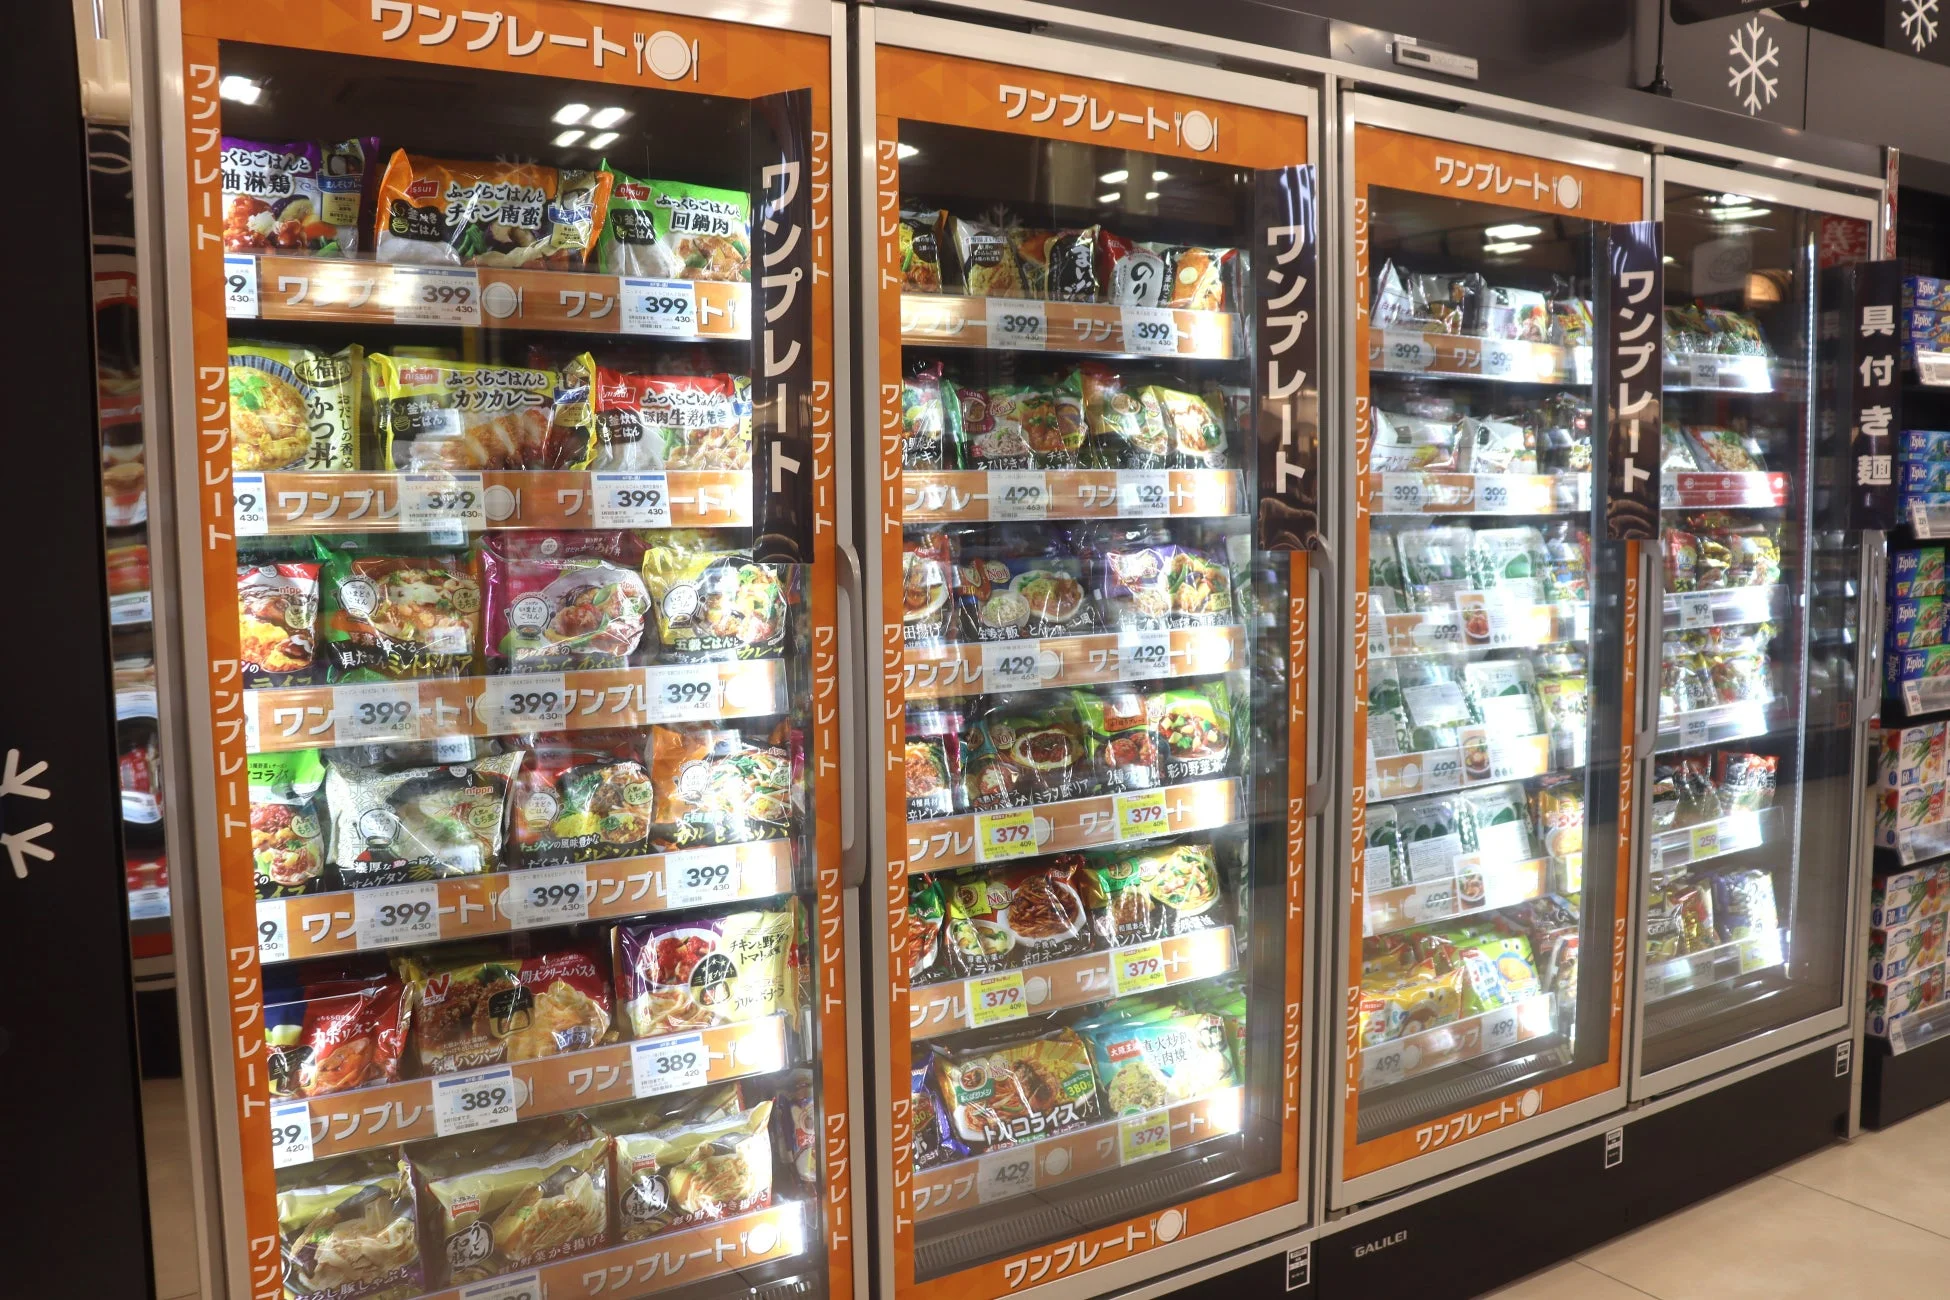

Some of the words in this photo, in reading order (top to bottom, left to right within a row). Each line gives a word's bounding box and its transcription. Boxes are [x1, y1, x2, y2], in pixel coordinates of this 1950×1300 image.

[371, 0, 627, 68] ワンプレート
[999, 83, 1171, 141] ワンプレート
[190, 64, 221, 250] ワンプレート
[221, 169, 292, 193] 油淋鶏
[1434, 155, 1550, 201] ワンプレート
[446, 204, 542, 227] チキン南蛮
[811, 131, 830, 285] ワンプレート
[878, 139, 898, 290] ワンプレート
[671, 212, 730, 235] 回鍋肉
[1355, 197, 1368, 320] ワンプレート
[422, 284, 471, 304] 399
[1918, 281, 1936, 297] Ziploc
[645, 296, 688, 315] 399
[762, 161, 803, 493] ワンプレート
[1003, 314, 1040, 333] 399
[1137, 321, 1170, 340] 399
[1913, 313, 1931, 328] Ziploc
[1266, 225, 1308, 494] ワンプレート
[446, 370, 546, 387] ふっくらごはんと
[1618, 270, 1656, 494] ワンプレート
[455, 389, 542, 409] カツカレー
[1857, 305, 1896, 487] 具付き麺
[307, 399, 338, 470] かつ丼
[1911, 434, 1926, 450] Ziploc
[200, 366, 232, 551] ワンプレート
[812, 379, 832, 534] ワンプレート
[881, 383, 900, 534] ワンプレート
[1355, 397, 1368, 518] ワンプレート
[1911, 466, 1928, 480] Ziploc
[427, 491, 476, 510] 399
[617, 490, 661, 507] 399
[1004, 486, 1040, 504] 429
[1898, 556, 1918, 573] Ziploc
[1898, 606, 1917, 622] Ziploc
[1133, 646, 1165, 664] 429
[1291, 598, 1305, 722] ワンプレート
[1354, 591, 1368, 713] ワンプレート
[1905, 654, 1925, 672] Ziploc
[1000, 656, 1035, 676] 429
[510, 693, 558, 715] 399
[667, 682, 712, 704] 399
[815, 626, 837, 777] ワンプレート
[883, 624, 903, 771] ワンプレート
[360, 702, 412, 724] 399
[213, 659, 247, 838] ワンプレート
[1432, 761, 1457, 777] 699
[1131, 805, 1162, 823] 379
[995, 825, 1030, 844] 379
[1351, 785, 1366, 904] ワンプレート
[1289, 798, 1303, 919] ワンプレート
[687, 865, 730, 888] 399
[532, 884, 580, 908] 399
[380, 901, 432, 927] 399
[819, 868, 842, 1014] ワンプレート
[887, 860, 907, 1002] ワンプレート
[521, 965, 597, 984] 明太クリームパスタ
[1128, 959, 1159, 978] 379
[985, 988, 1020, 1007] 379
[231, 945, 265, 1118] ワンプレート
[1491, 1018, 1514, 1036] 499
[1110, 1043, 1136, 1057] 大阪王
[1346, 985, 1360, 1100] ワンプレート
[656, 1052, 697, 1075] 389
[1286, 1002, 1300, 1121] ワンプレート
[1376, 1053, 1401, 1073] 499
[461, 1087, 506, 1112] 389
[984, 1102, 1080, 1146] トルコライス
[1416, 1098, 1515, 1151] ワンプレート
[1135, 1126, 1165, 1147] 379
[891, 1098, 912, 1234] ワンプレート
[995, 1160, 1031, 1182] 429
[827, 1112, 849, 1250] ワンプレート
[671, 1187, 769, 1226] 彩り野かき揚げと
[1355, 1229, 1408, 1258] GALILEI
[583, 1237, 737, 1296] ワンプレート
[1003, 1224, 1149, 1288] ワンプレート
